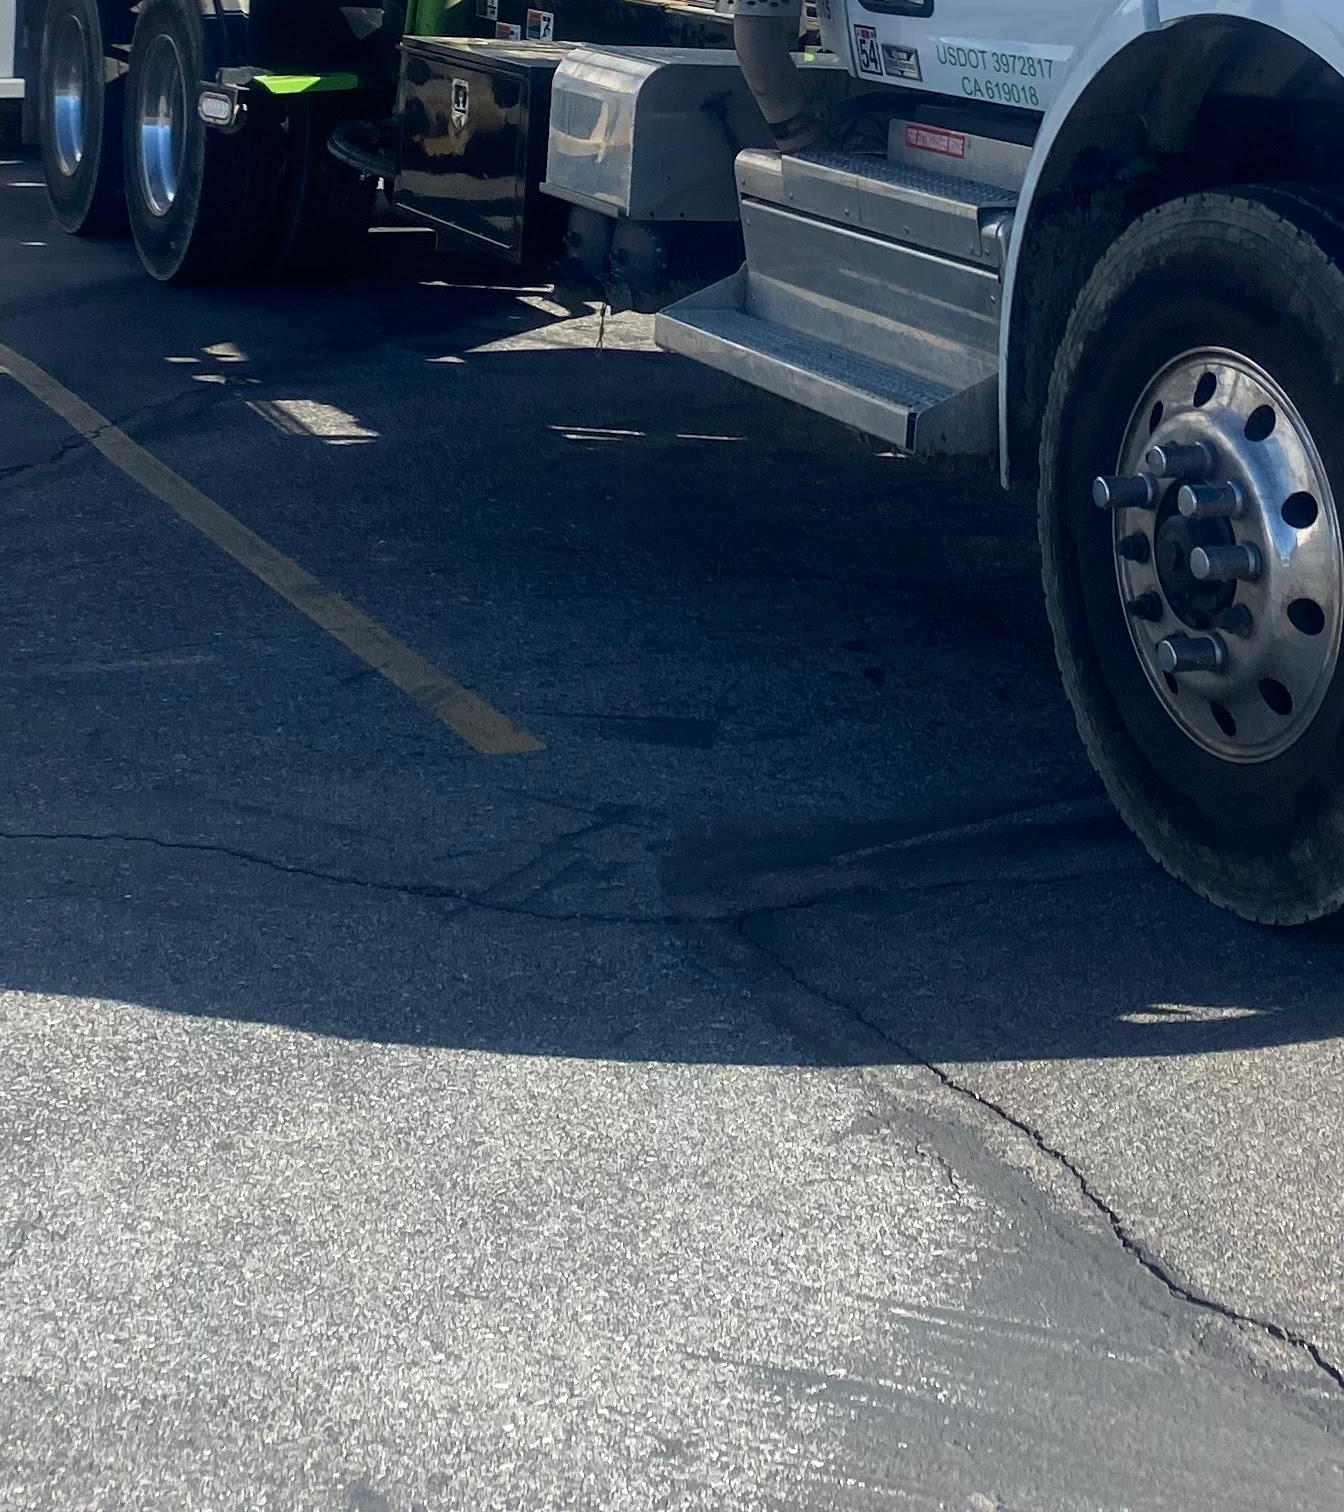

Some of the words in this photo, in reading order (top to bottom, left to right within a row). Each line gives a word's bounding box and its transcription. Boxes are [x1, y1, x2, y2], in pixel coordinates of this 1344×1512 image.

[859, 39, 879, 70] 54
[936, 45, 987, 70] USDOT
[991, 51, 1053, 79] 3972817
